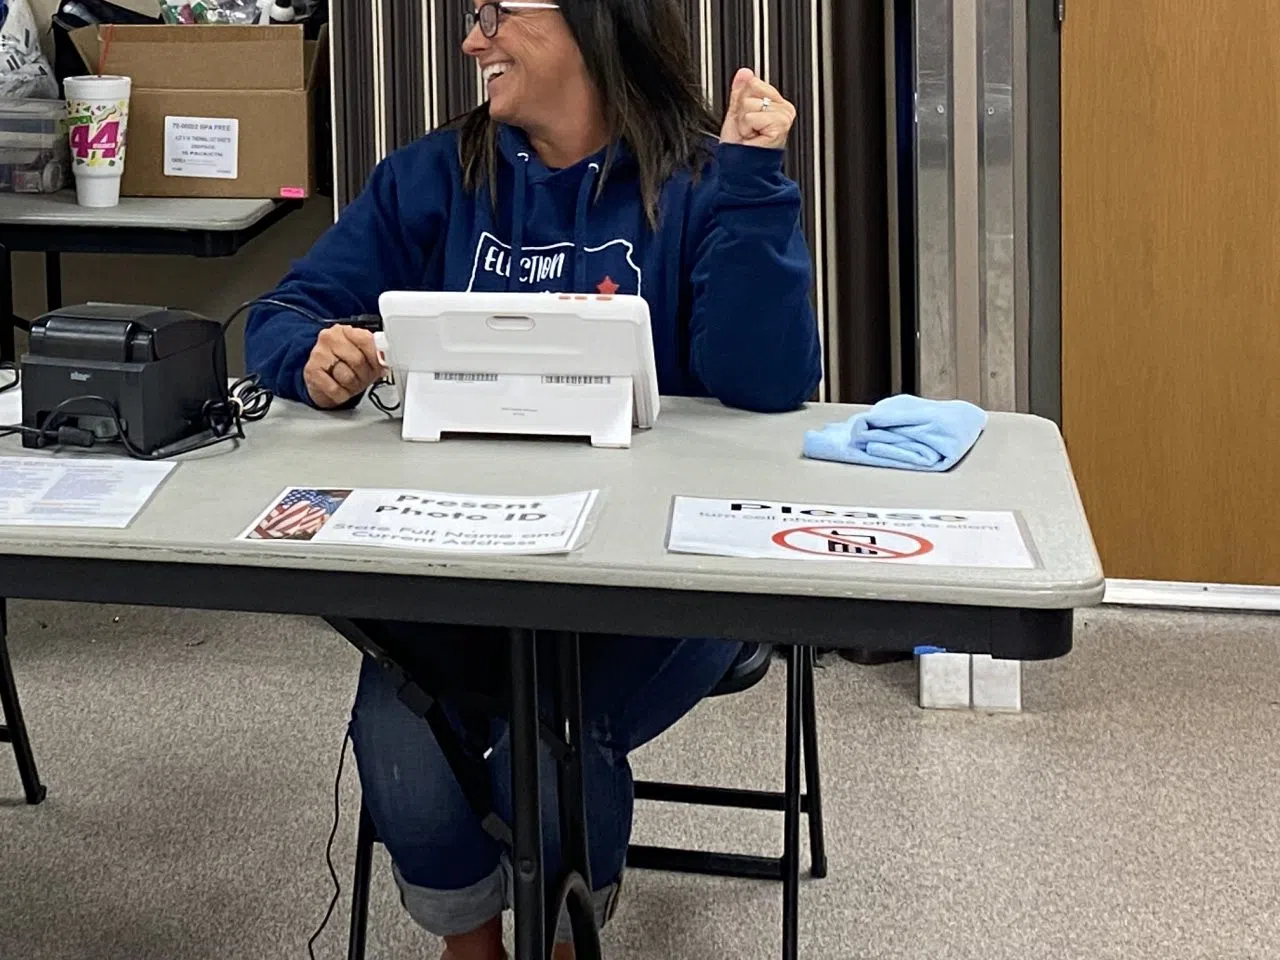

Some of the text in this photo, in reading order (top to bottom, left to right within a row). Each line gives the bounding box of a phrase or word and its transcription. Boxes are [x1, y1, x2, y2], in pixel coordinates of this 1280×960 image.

[70, 121, 120, 159] 44
[395, 495, 543, 510] Present
[375, 505, 547, 522] Photo ID
[698, 511, 737, 519] turn
[782, 517, 856, 525] phones
[730, 503, 969, 522] Please
[332, 523, 567, 539] State Full Name and
[351, 531, 435, 543] Current
